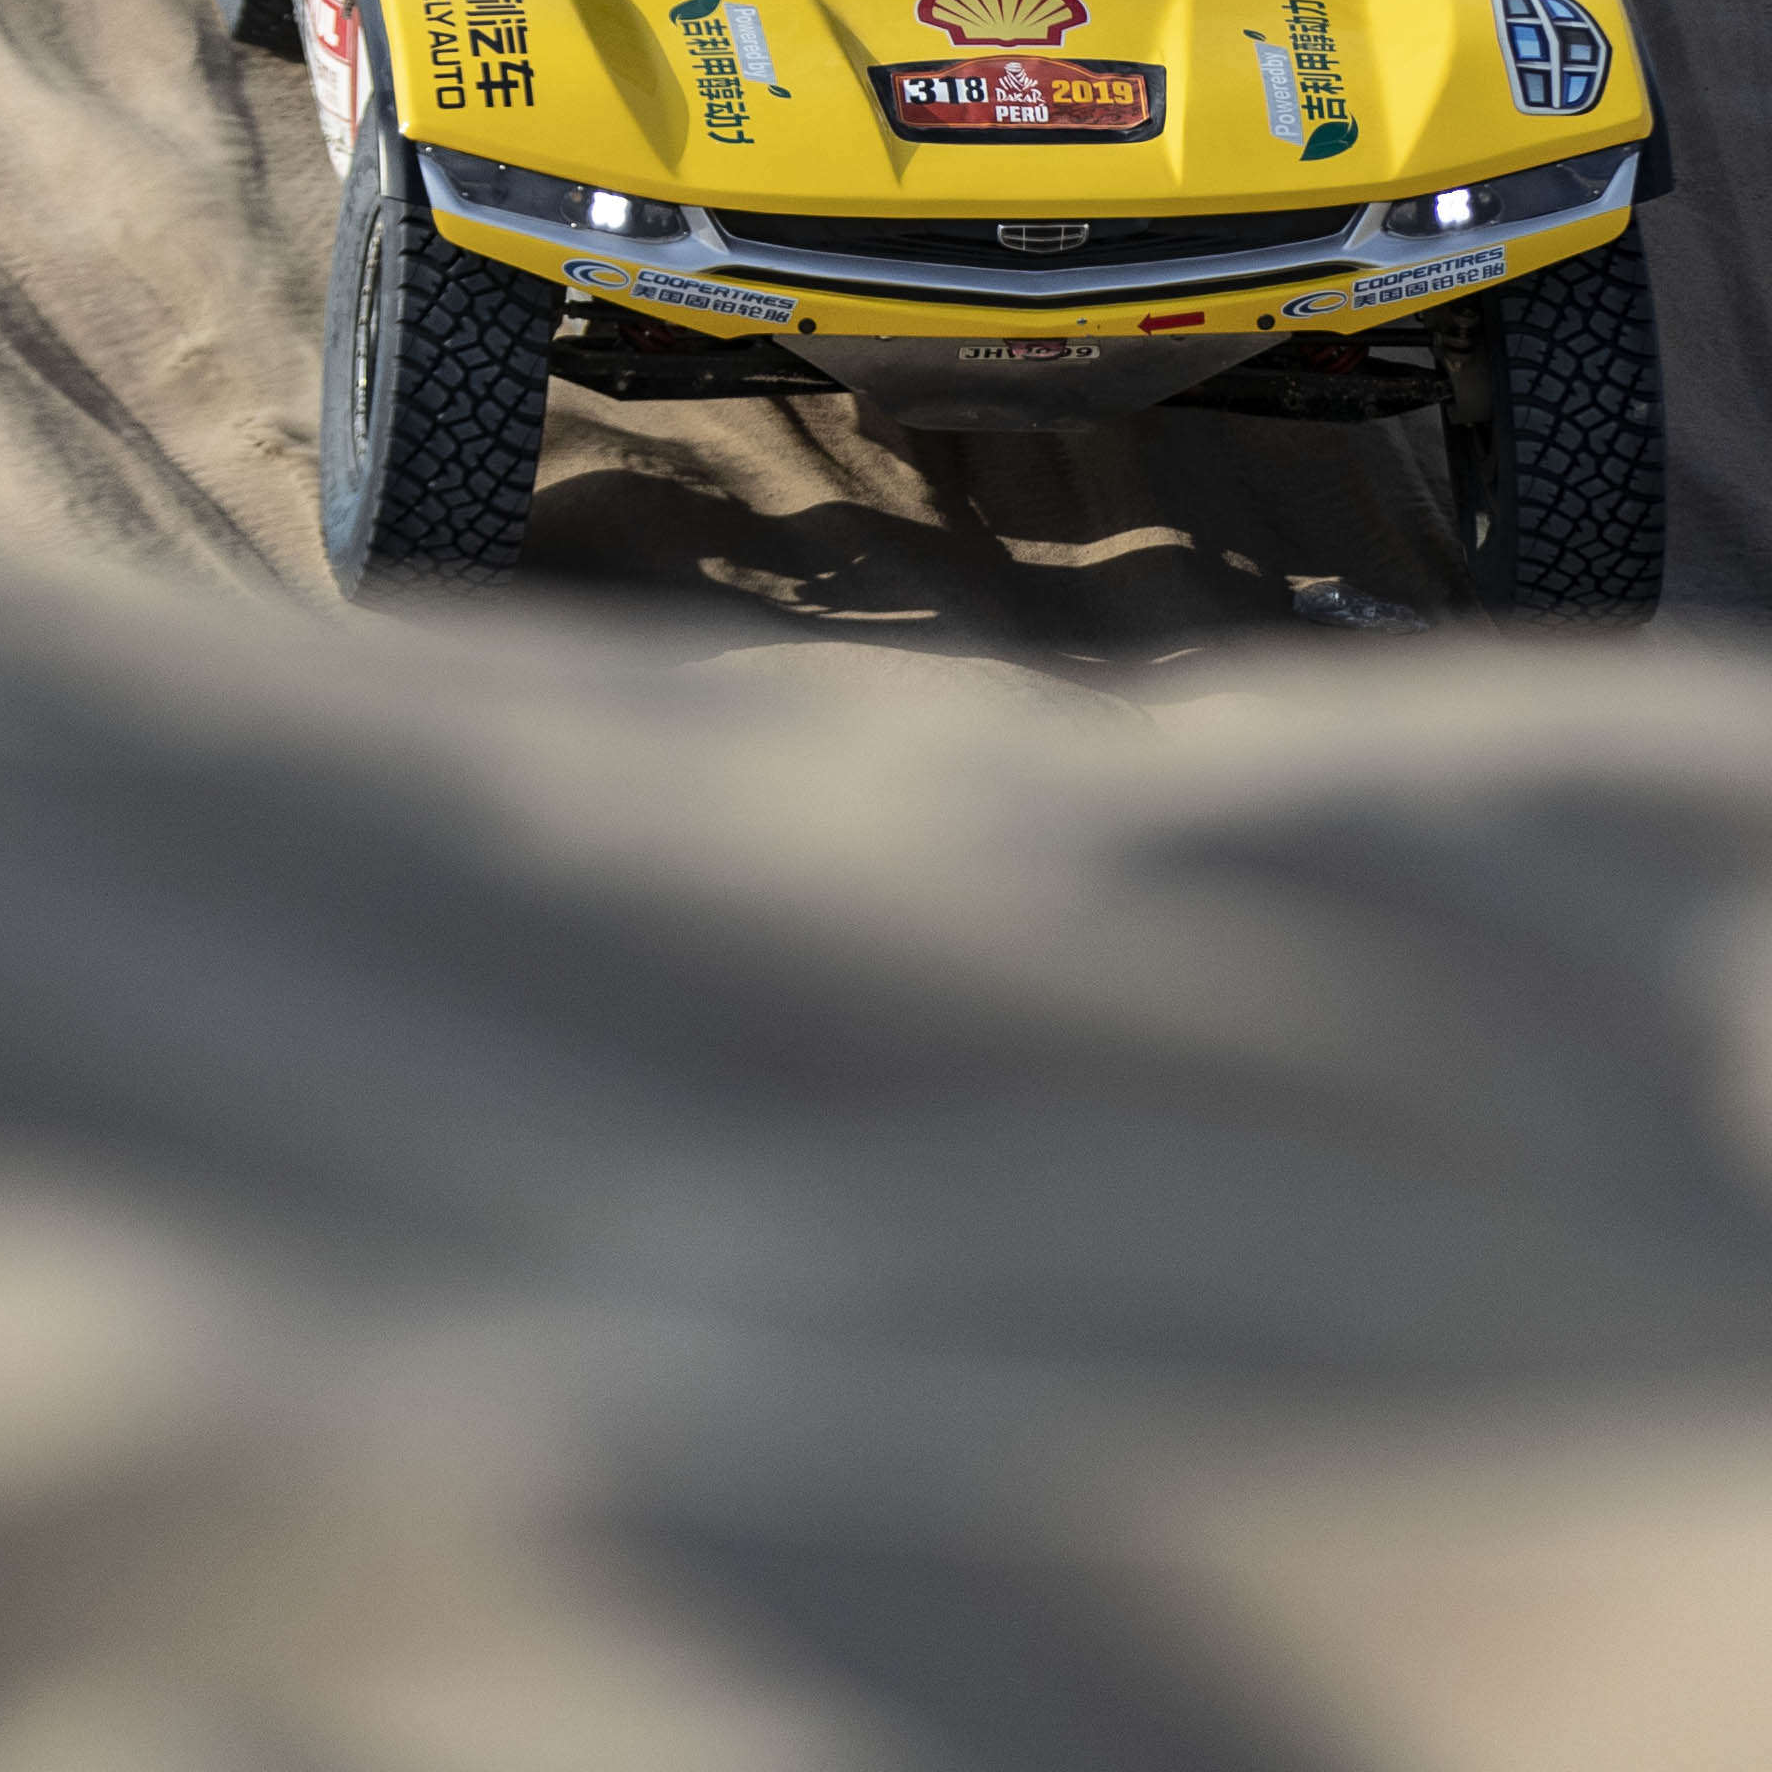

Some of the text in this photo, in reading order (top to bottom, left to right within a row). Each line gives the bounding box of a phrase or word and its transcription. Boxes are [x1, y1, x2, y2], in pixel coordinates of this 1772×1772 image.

[733, 6, 766, 61] Powered
[428, 31, 467, 110] AUTO
[907, 76, 986, 104] 318
[994, 87, 1046, 104] DAKAR
[1051, 79, 1135, 105] 2019
[995, 103, 1049, 123] PERÚ
[1353, 246, 1504, 293] COOPERTIRES
[638, 270, 796, 310] COOPERTIRES
